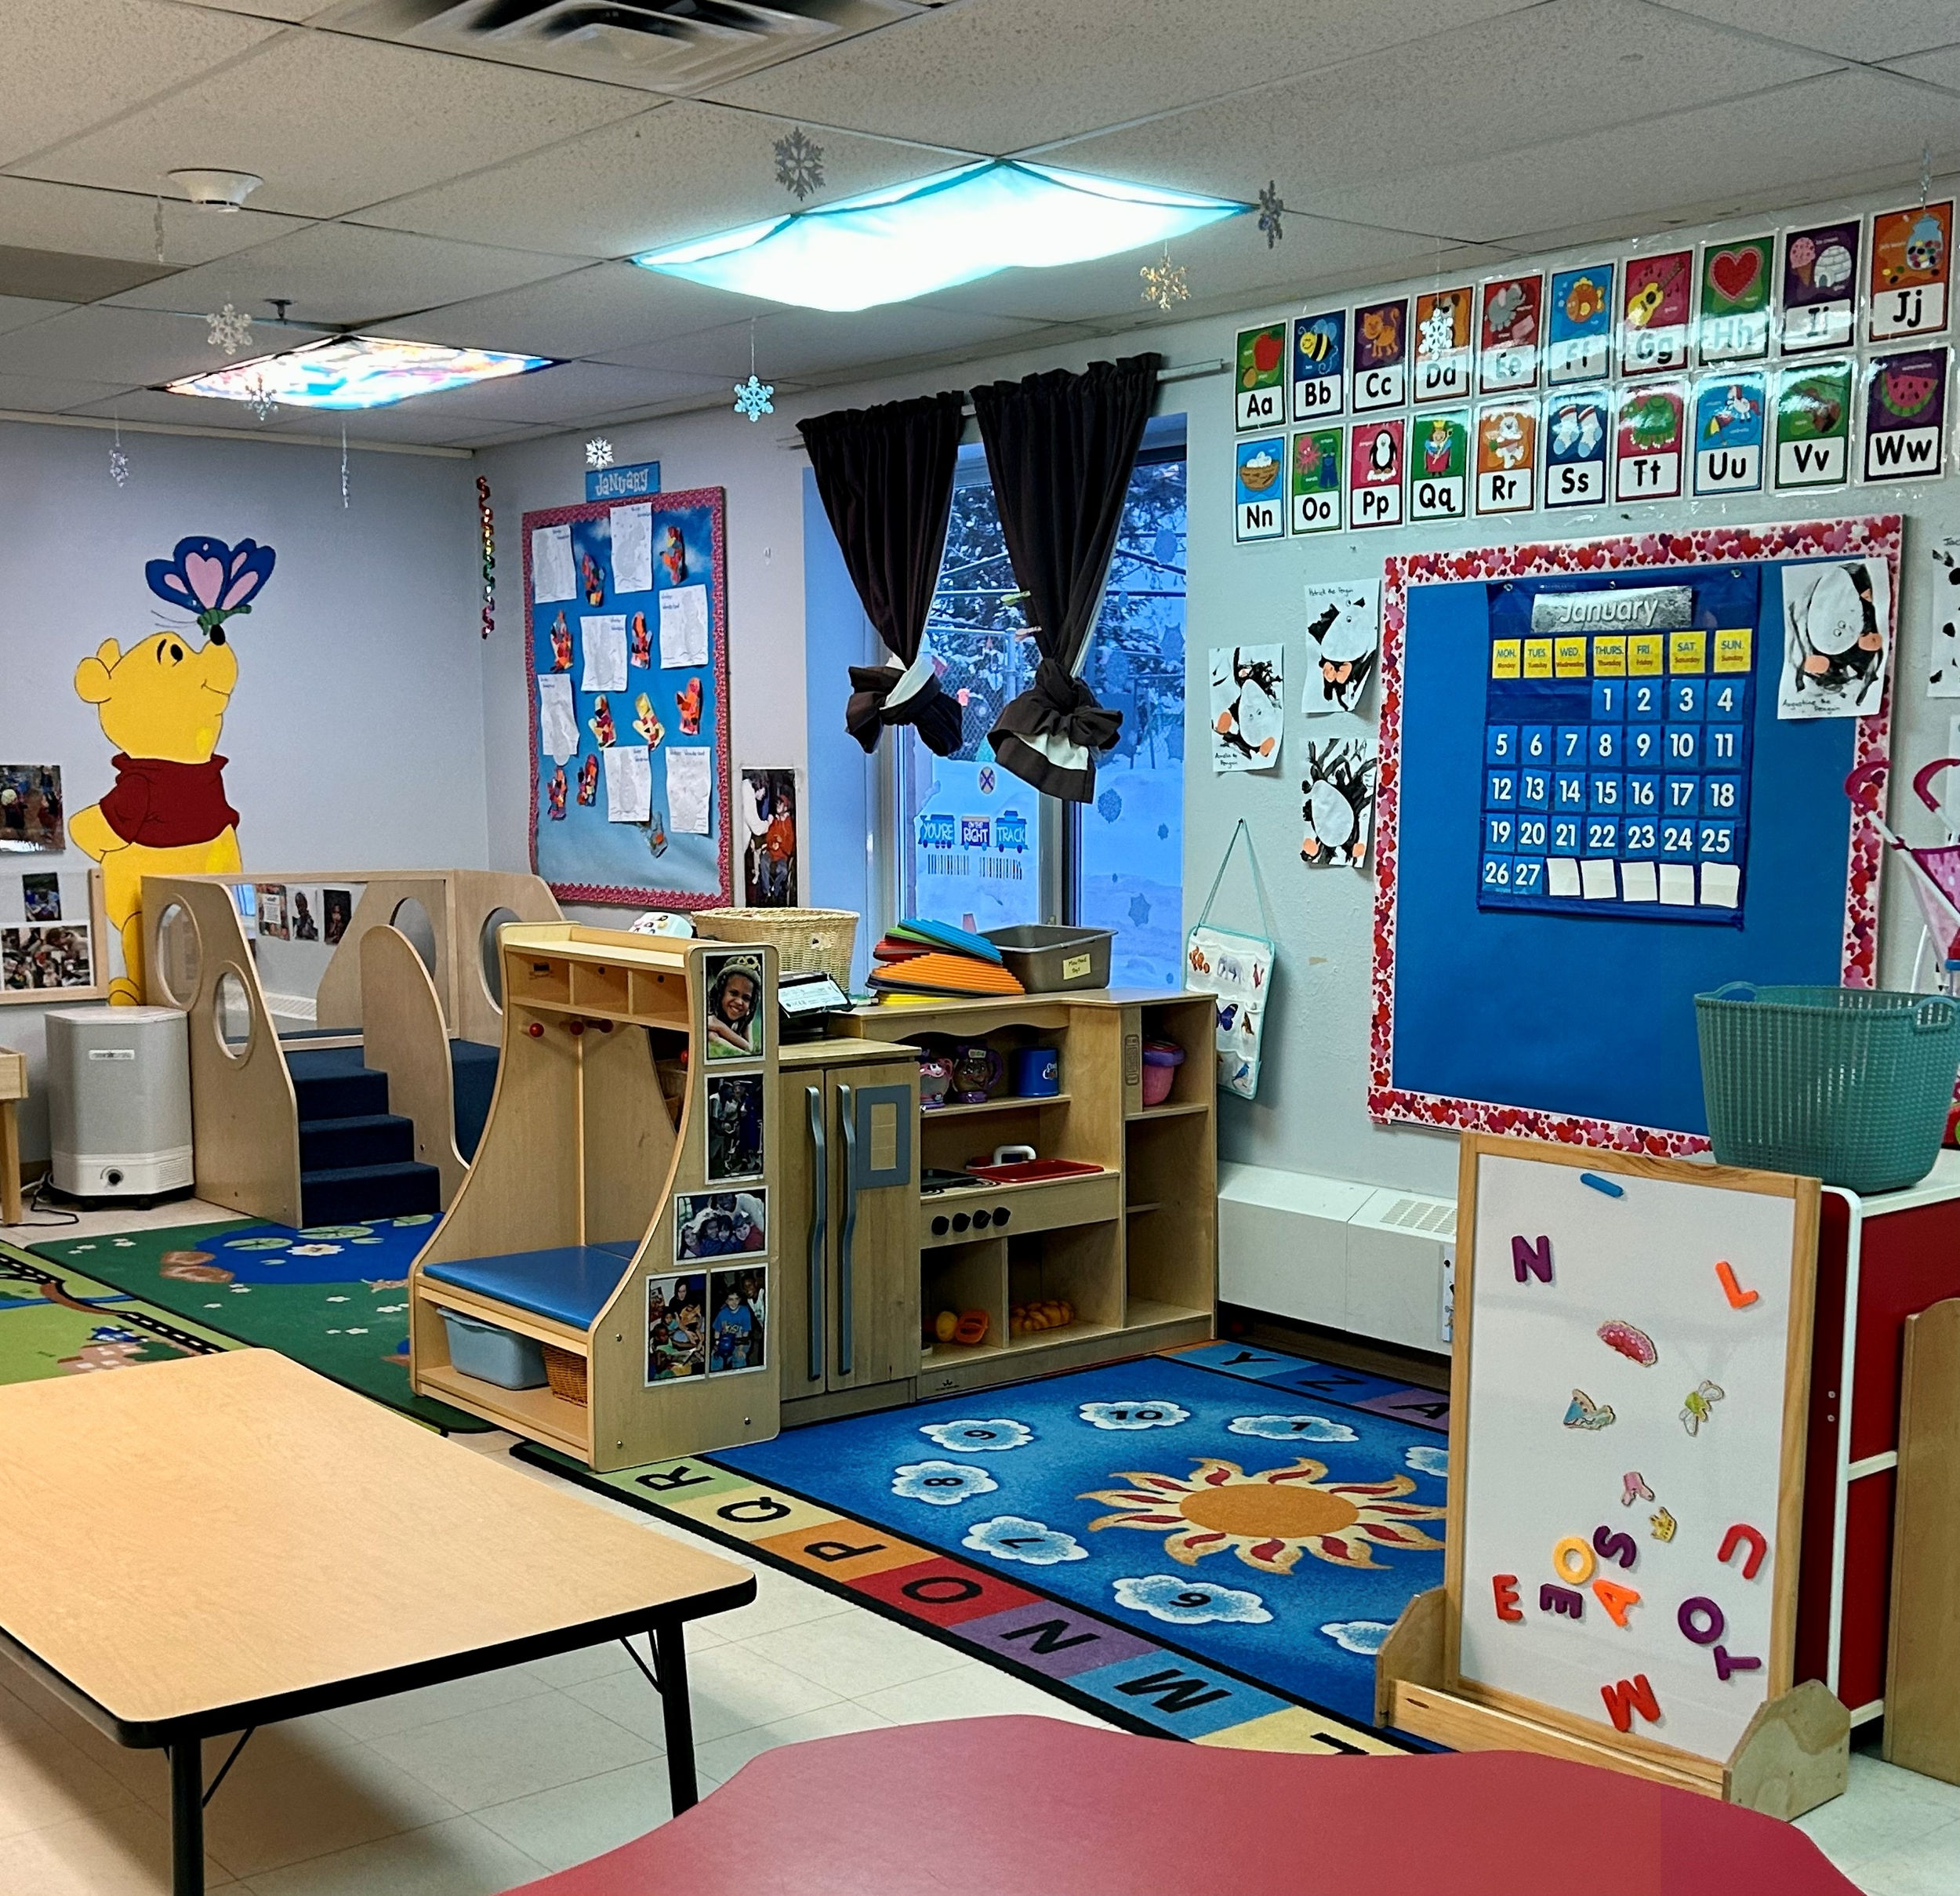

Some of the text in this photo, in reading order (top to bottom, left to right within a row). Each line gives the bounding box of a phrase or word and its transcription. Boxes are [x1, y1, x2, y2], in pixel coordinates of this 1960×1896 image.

[1806, 306, 1830, 337] Ii
[1893, 289, 1922, 328] Jj
[1714, 318, 1753, 349] Hh
[1636, 332, 1675, 365] Gg
[1426, 360, 1456, 389] Dd
[1496, 352, 1523, 379] Ee
[1305, 380, 1331, 407] Bb
[1366, 372, 1392, 398] Cc
[1247, 394, 1273, 419] Aa
[1794, 444, 1830, 473] Vv
[1875, 434, 1933, 466] Ww
[1561, 467, 1589, 494] Ss
[1633, 459, 1661, 487] Tt
[1708, 452, 1747, 481] Uu
[1419, 483, 1456, 512] Qq
[1492, 474, 1517, 501] Rr
[1247, 504, 1273, 529] Nn
[1302, 496, 1331, 521] Oo
[1363, 491, 1389, 521] Pp
[1559, 598, 1659, 627] January
[1560, 647, 1581, 656] WED.
[1595, 645, 1624, 656] THURS.
[1721, 640, 1744, 650] SUN.
[1603, 688, 1733, 712] 1 2 3 4
[1495, 733, 1733, 757] 5 6 7 8 9 10 11
[1492, 776, 1734, 807] 12 13 14 15 16 17 18
[963, 827, 988, 843] RIGHT
[996, 826, 1025, 842] TRACK
[1491, 821, 1731, 852] 19 20 21 22 23 24 25
[1485, 862, 1541, 886] 26 27
[1511, 1234, 1553, 1284] N
[1715, 1260, 1759, 1309] L
[1220, 1351, 1281, 1366] Y
[1109, 1410, 1163, 1420] 10
[1388, 1402, 1450, 1420] A
[964, 1429, 997, 1440] 9
[1291, 1422, 1312, 1432] 1
[635, 1466, 715, 1491] R
[923, 1477, 964, 1487] 8
[717, 1495, 792, 1524] Q
[804, 1541, 888, 1562] P
[1553, 1536, 1596, 1585] O
[1592, 1525, 1636, 1568] S
[902, 1576, 983, 1604] O
[1492, 1574, 1523, 1621] E
[1592, 1578, 1641, 1627] A
[1677, 1596, 1725, 1644] O
[999, 1618, 1102, 1655] N
[1713, 1644, 1762, 1681] T
